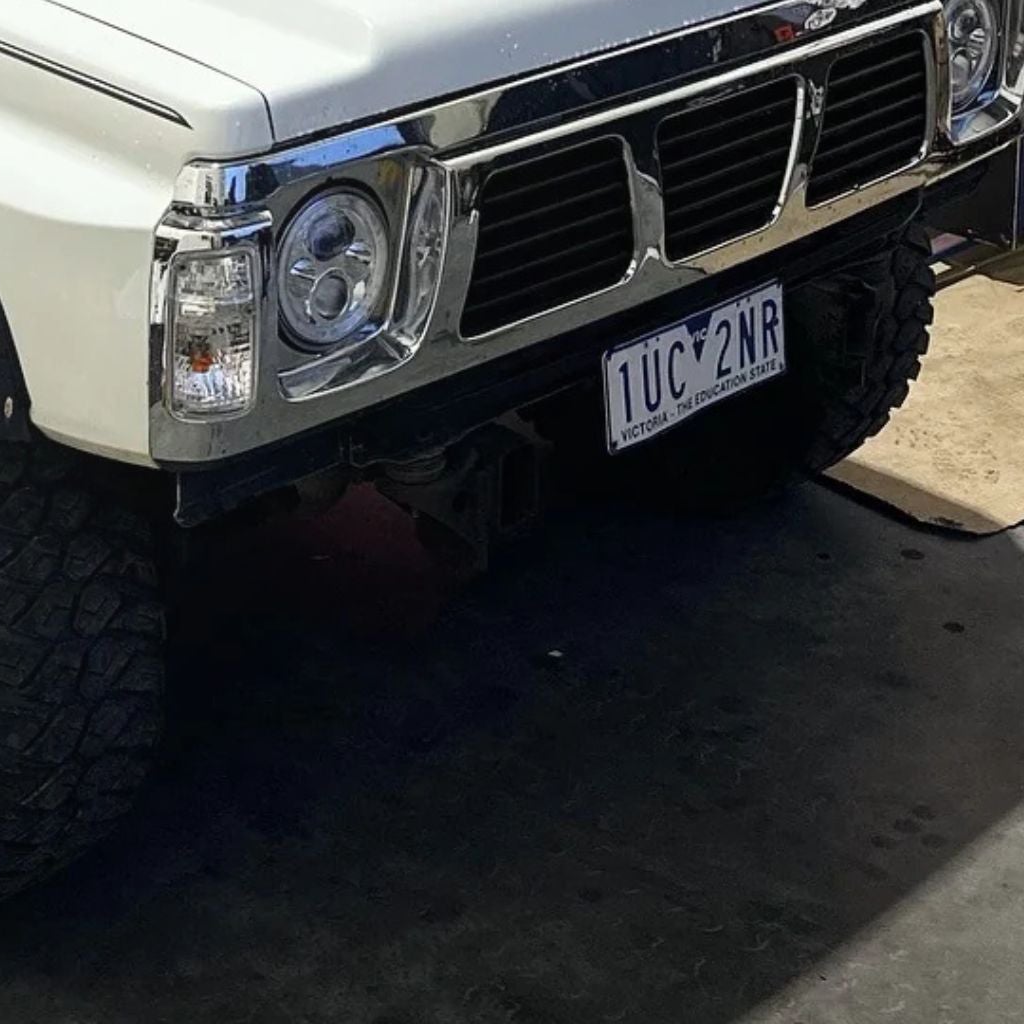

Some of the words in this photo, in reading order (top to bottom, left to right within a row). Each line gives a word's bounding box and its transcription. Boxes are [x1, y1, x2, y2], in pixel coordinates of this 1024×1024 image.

[618, 340, 687, 423] 1UC
[715, 298, 779, 381] 2NR
[620, 410, 669, 442] VICTORIA
[677, 396, 694, 415] THE
[694, 372, 748, 409] EDUCATION
[749, 357, 777, 381] STATE
